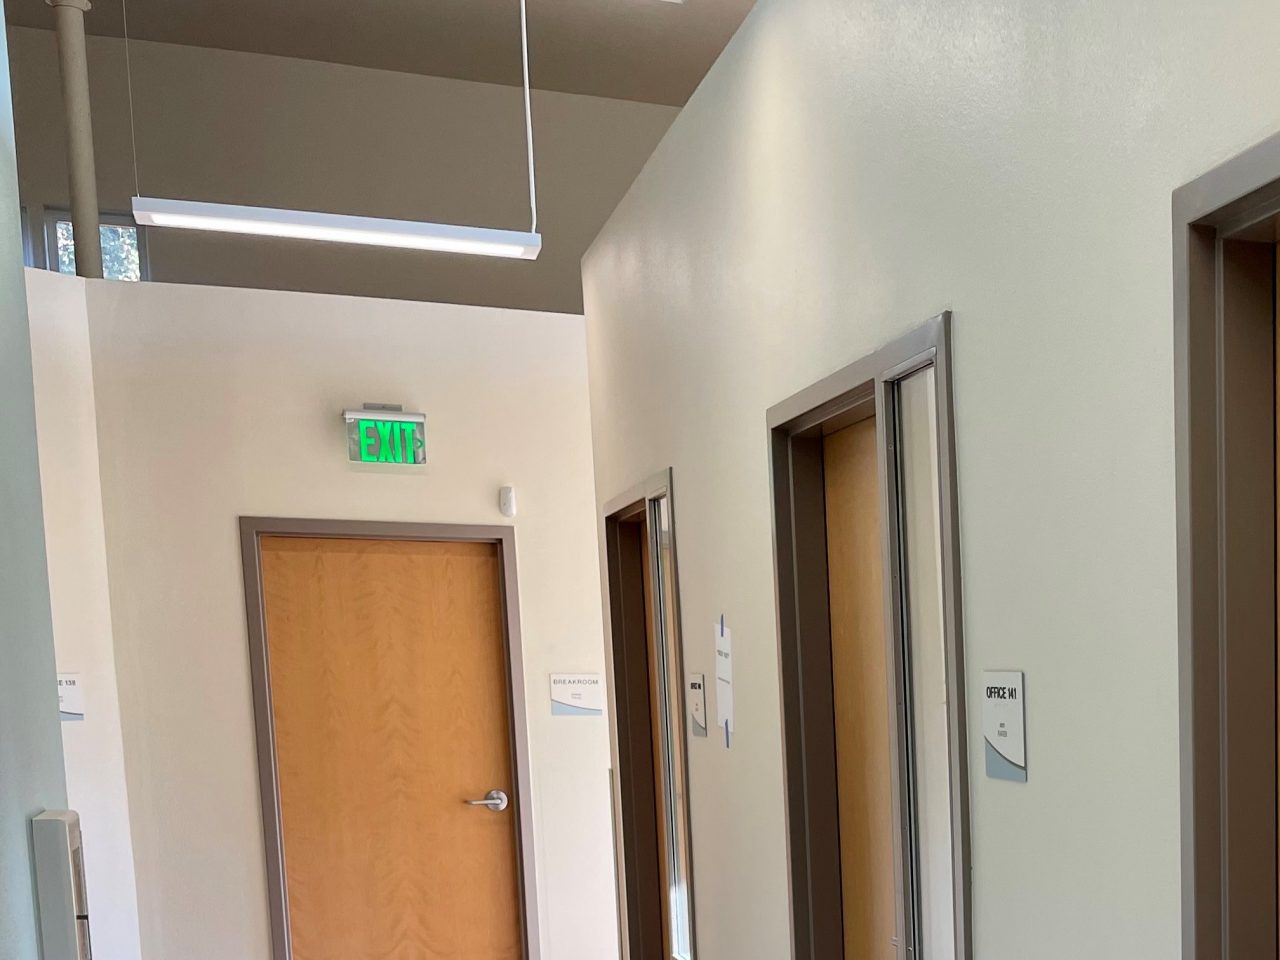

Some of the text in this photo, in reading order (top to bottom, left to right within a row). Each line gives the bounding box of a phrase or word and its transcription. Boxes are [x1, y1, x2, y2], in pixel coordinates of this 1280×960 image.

[358, 419, 416, 464] EXIT
[986, 686, 1017, 700] OFFICE 141
